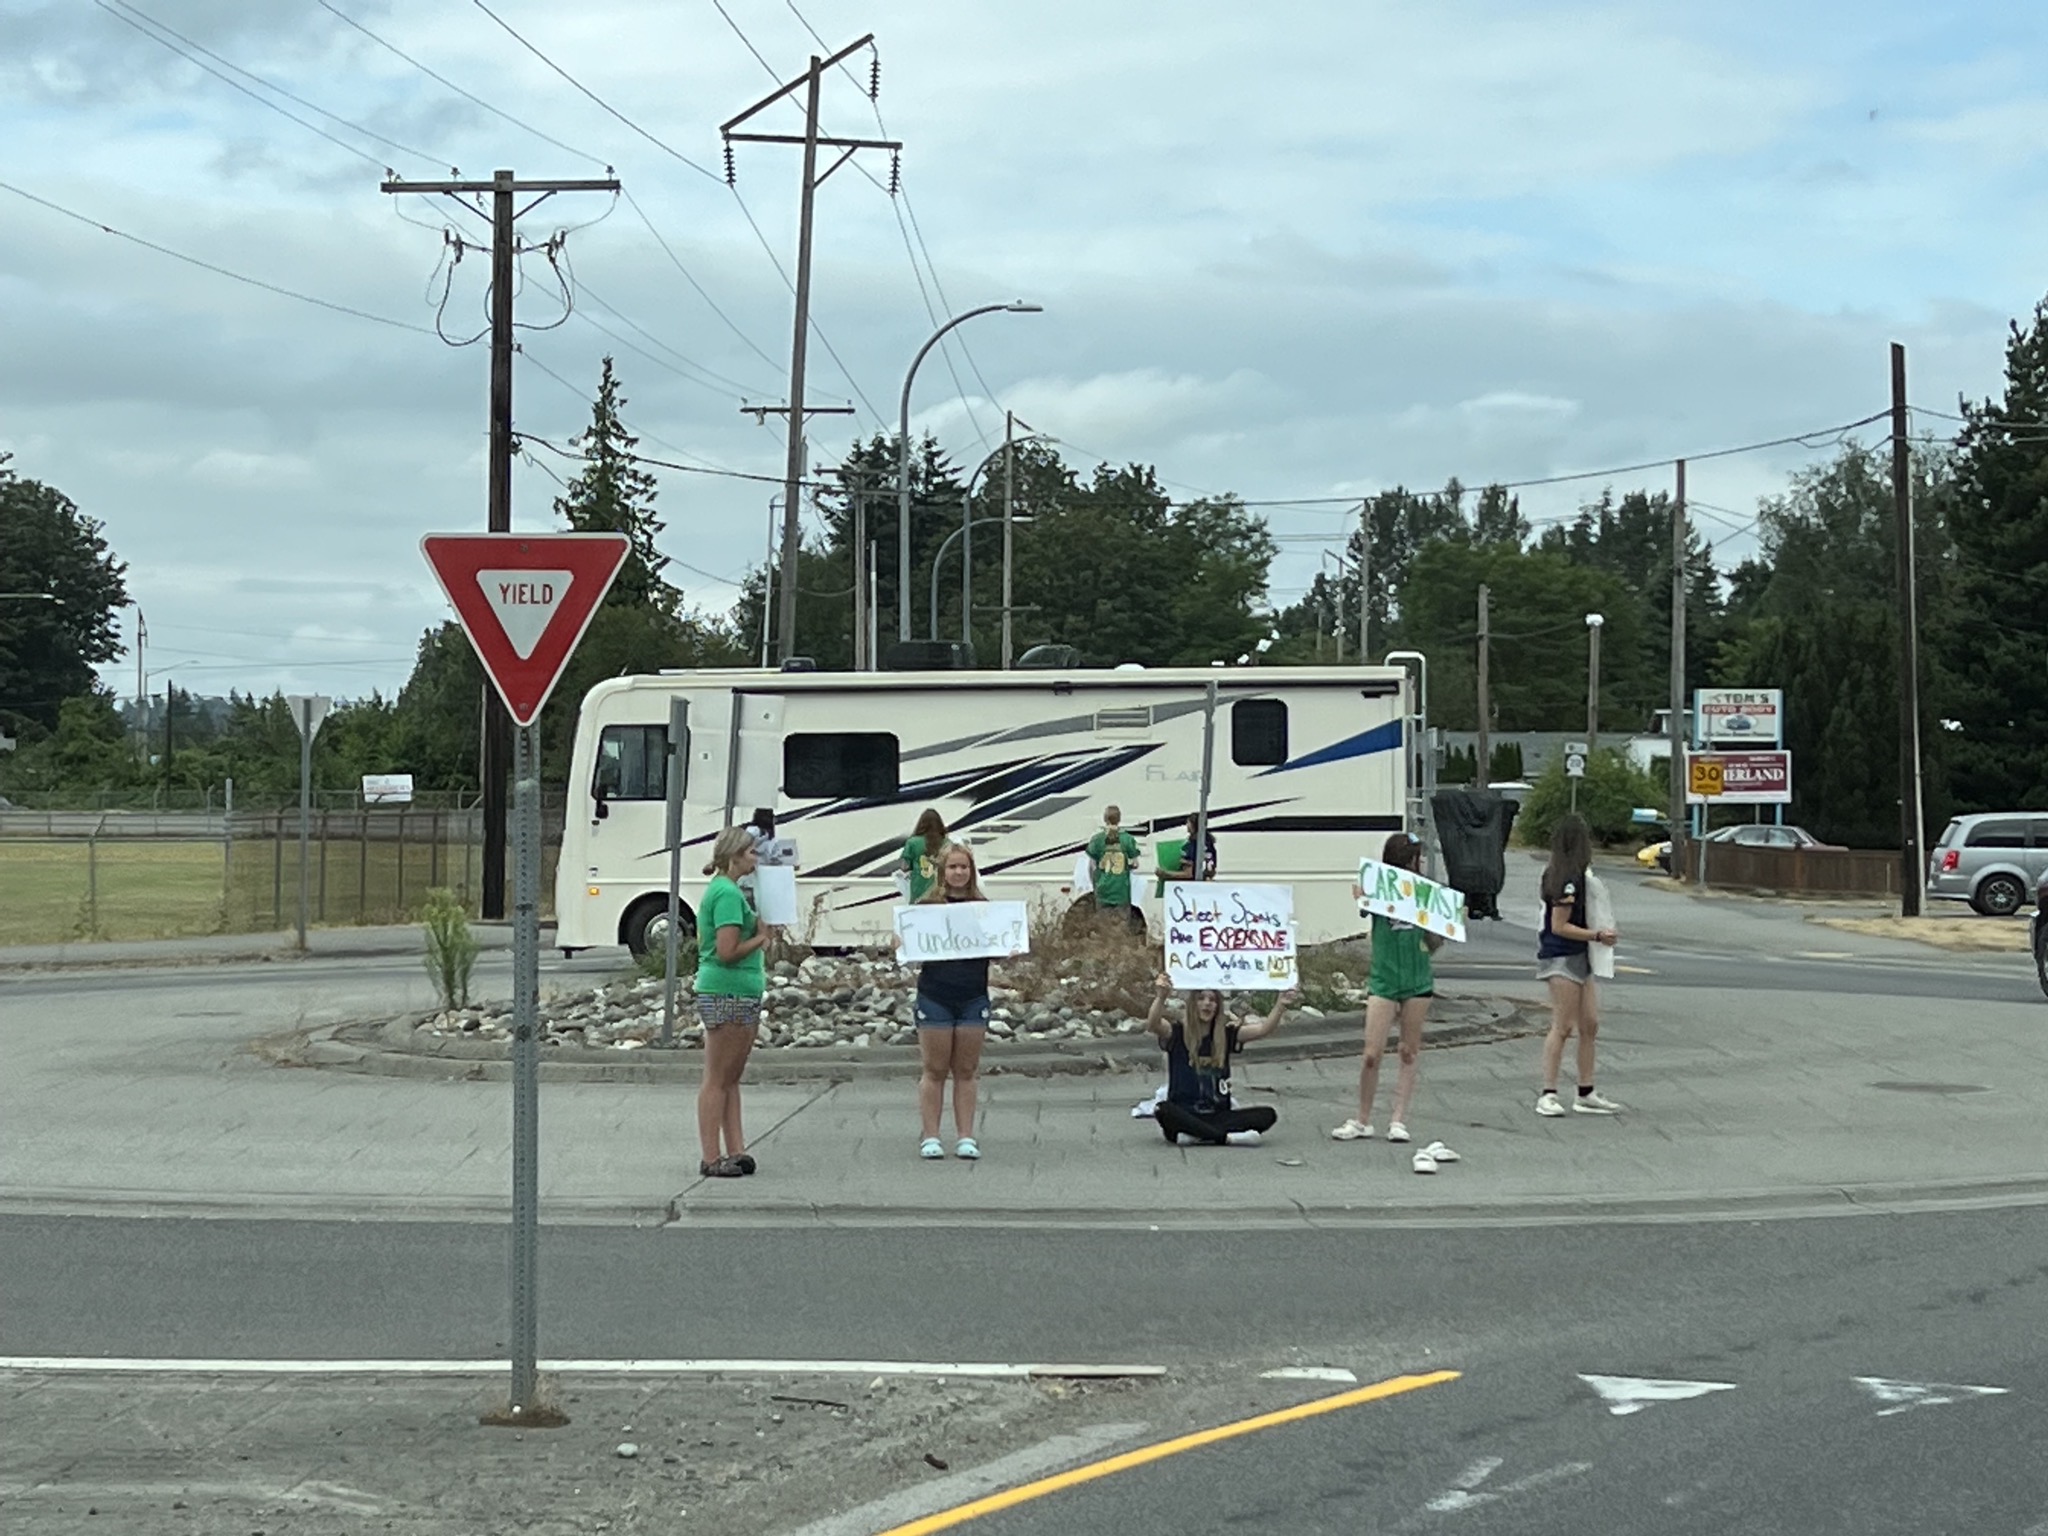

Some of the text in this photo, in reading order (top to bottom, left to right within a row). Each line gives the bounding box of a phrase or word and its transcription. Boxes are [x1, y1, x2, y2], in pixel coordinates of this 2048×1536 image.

[499, 583, 553, 605] YIELD
[1694, 766, 1721, 781] 30
[1169, 886, 1222, 923] Select
[1360, 862, 1464, 925] CAR WASH
[898, 908, 1023, 956] Fundraiser!
[1169, 952, 1183, 968] A
[1186, 951, 1210, 970] Car
